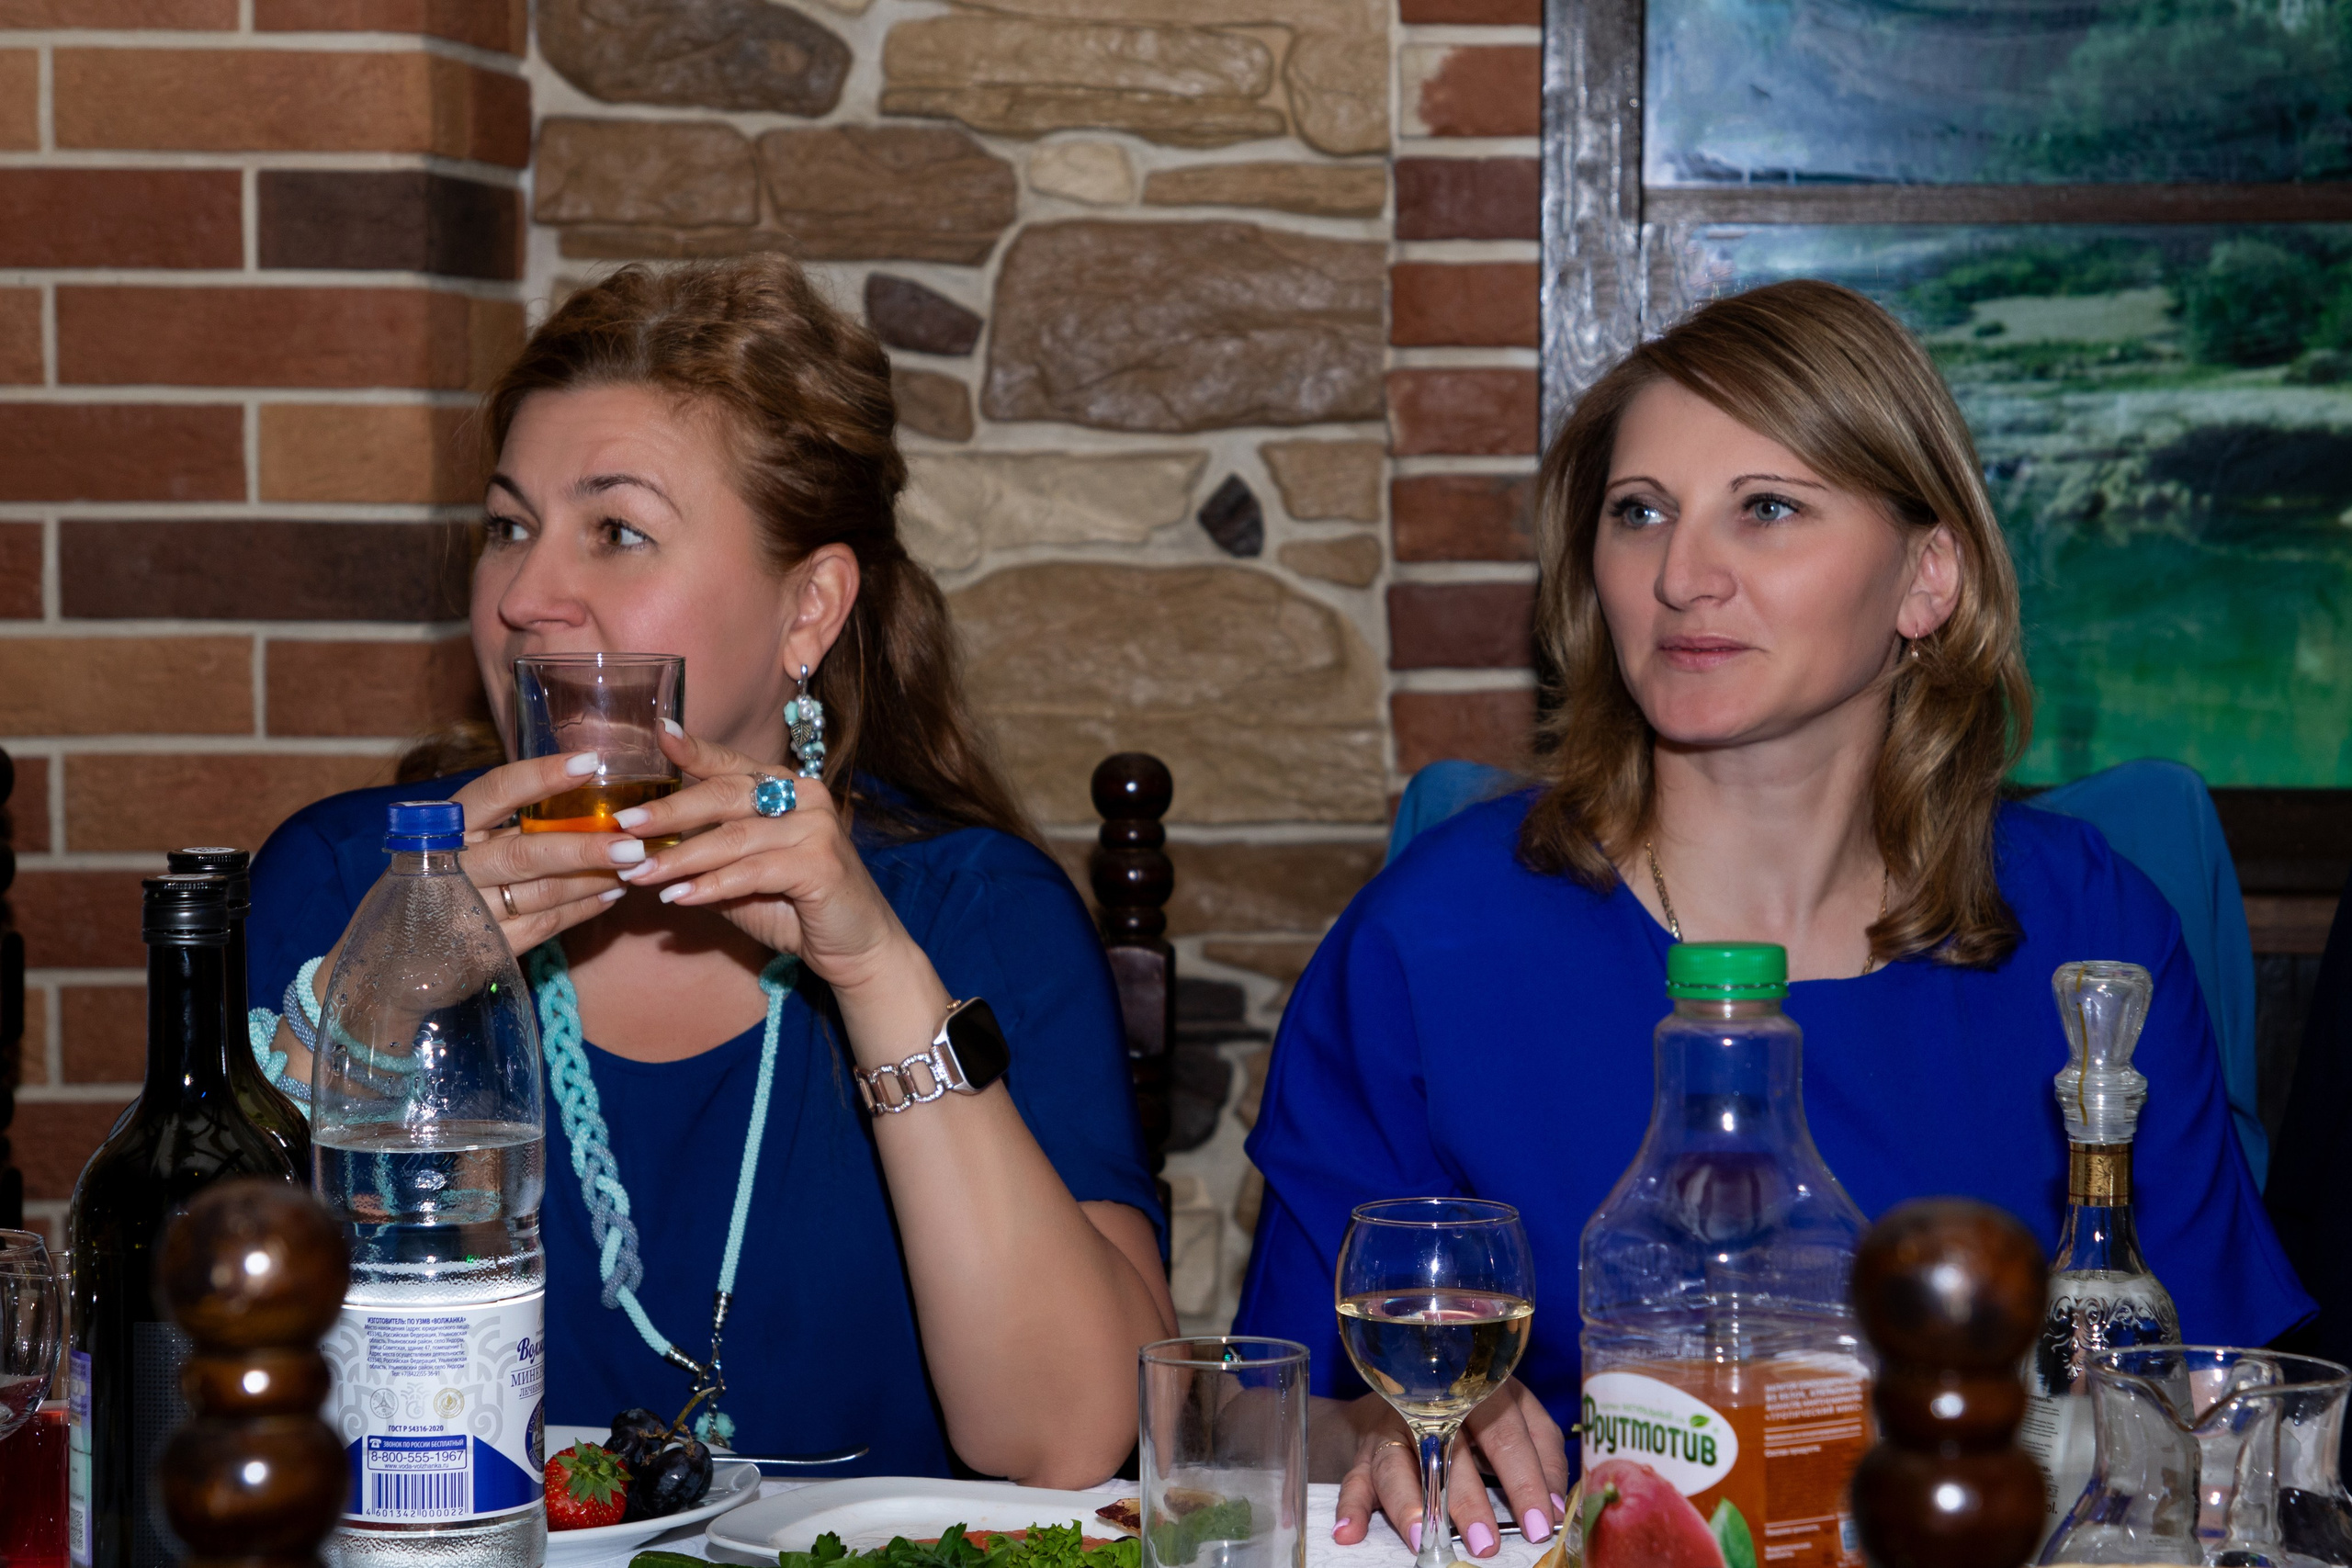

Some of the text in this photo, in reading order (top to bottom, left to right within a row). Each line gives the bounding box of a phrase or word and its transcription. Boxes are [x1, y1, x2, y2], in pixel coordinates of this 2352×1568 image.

[431, 1439, 464, 1448] БЕСПЛАТНЫЙ
[371, 1451, 464, 1463] 8-800-555-1967
[376, 1510, 416, 1518] 601342
[422, 1508, 464, 1517] 000022
